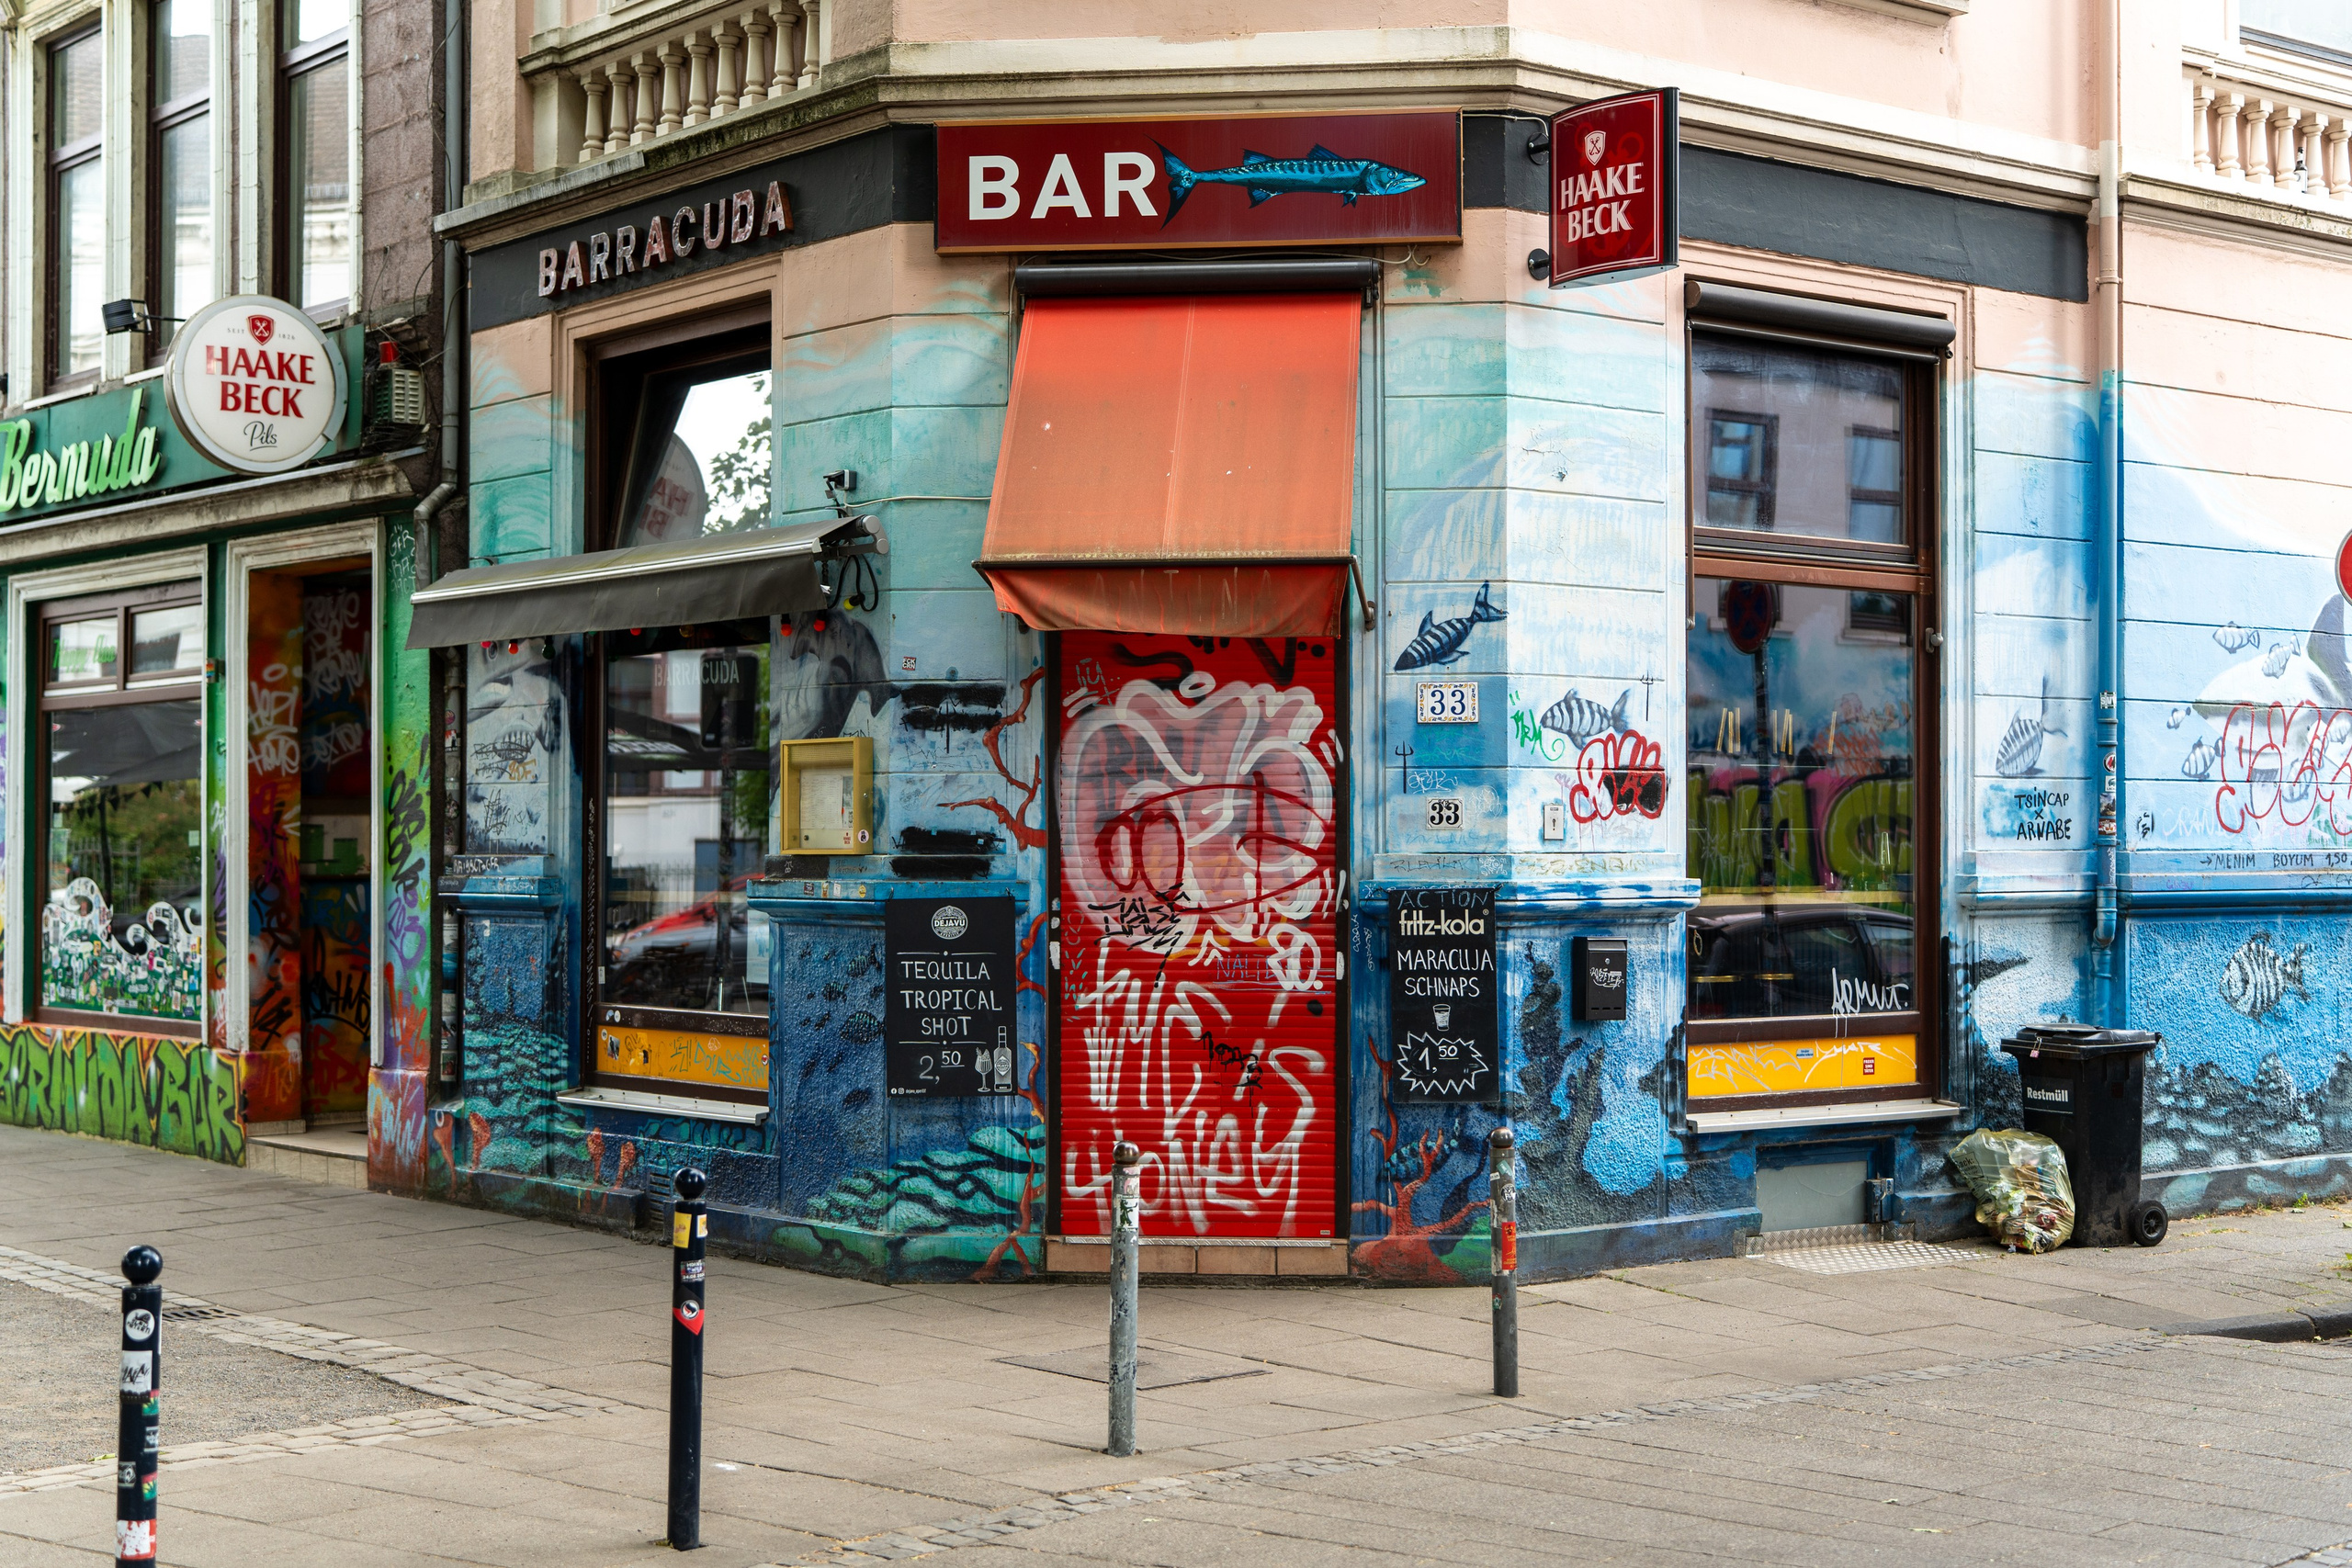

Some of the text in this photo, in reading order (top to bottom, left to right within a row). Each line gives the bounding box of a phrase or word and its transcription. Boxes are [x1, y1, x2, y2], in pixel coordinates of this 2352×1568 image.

[968, 152, 1158, 220] BAR
[1560, 162, 1645, 210] HAAKE
[1567, 199, 1634, 243] BECK
[538, 180, 787, 298] BARRACUDA
[205, 344, 315, 385] HAAKE
[220, 380, 304, 419] BECK
[243, 421, 277, 446] Pils
[0, 389, 161, 513] Bermuda
[654, 660, 740, 686] BARRACUDA
[1430, 689, 1467, 716] 33
[1430, 801, 1460, 826] 33
[2017, 818, 2072, 840] ARNABE
[2274, 853, 2313, 867] BOYUM
[1399, 909, 1485, 936] fritz-kola
[900, 961, 990, 981] TEQUILA
[1397, 949, 1494, 972] MARACUJA
[899, 988, 1002, 1011] TROPICAL
[1404, 976, 1480, 998] SCHNAPS
[921, 1016, 972, 1036] SHOT
[2027, 1085, 2069, 1102] Restmüll
